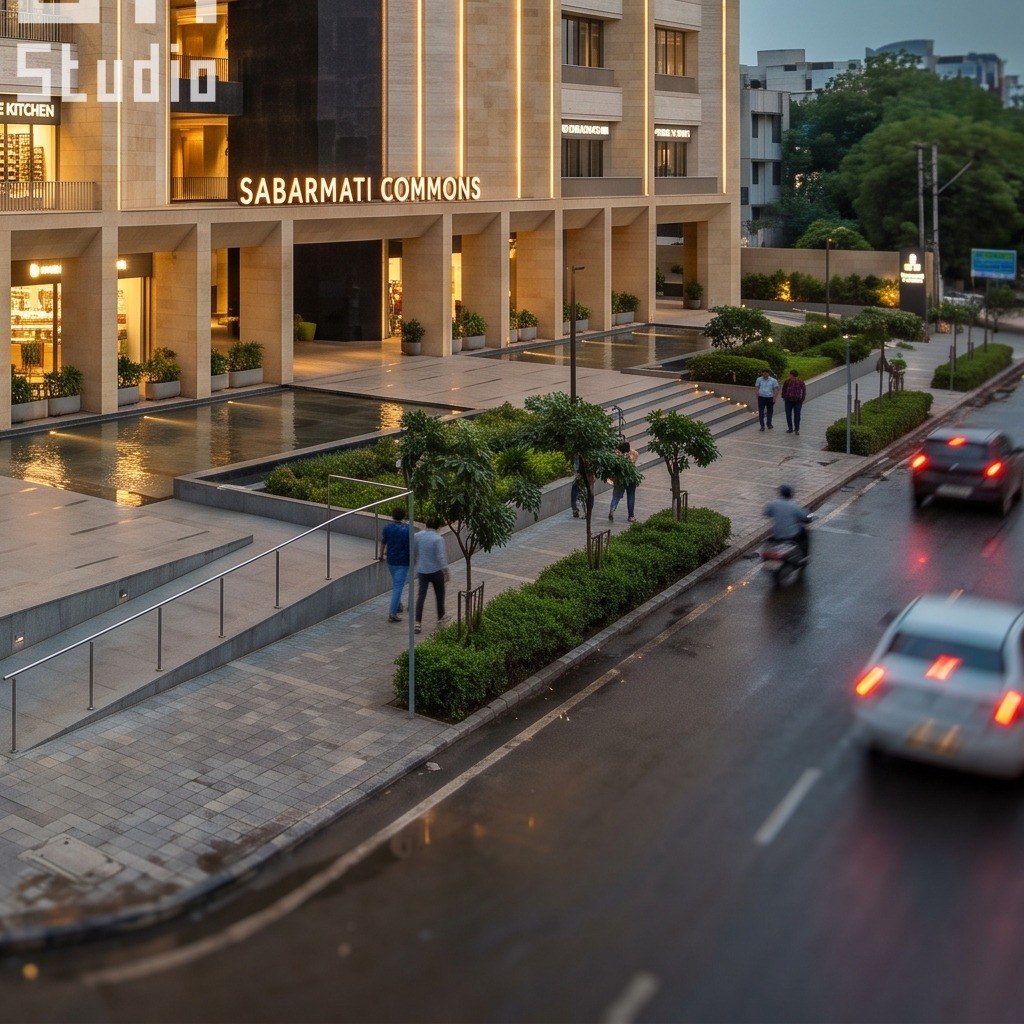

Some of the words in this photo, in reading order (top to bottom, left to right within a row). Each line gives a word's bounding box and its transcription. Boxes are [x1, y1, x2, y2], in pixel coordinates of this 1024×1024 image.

[6, 102, 55, 117] KITCHEN
[239, 176, 372, 206] SABARMATI
[380, 175, 482, 202] COMMONS
